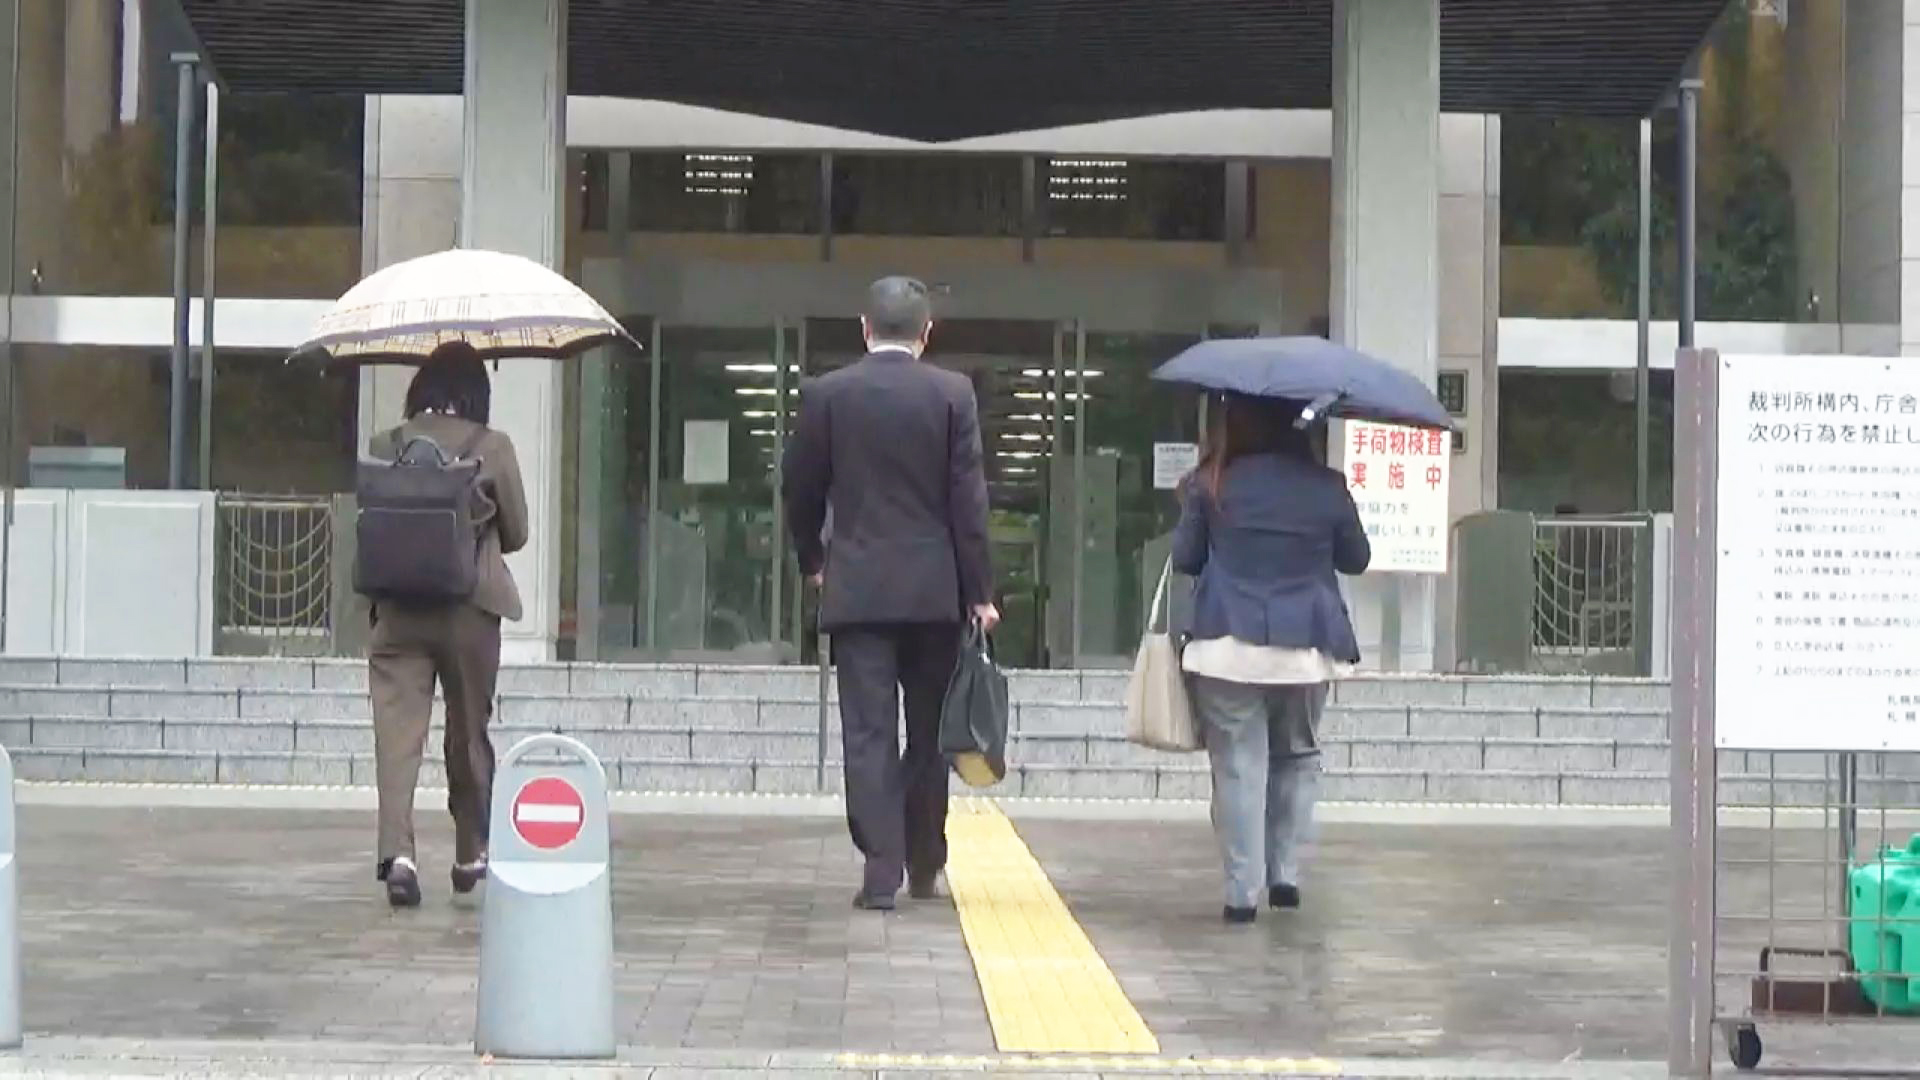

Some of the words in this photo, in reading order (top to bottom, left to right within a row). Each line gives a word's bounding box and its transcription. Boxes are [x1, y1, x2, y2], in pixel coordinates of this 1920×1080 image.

[1352, 426, 1443, 456] 手荷物検査
[1350, 462, 1442, 491] 実施中
